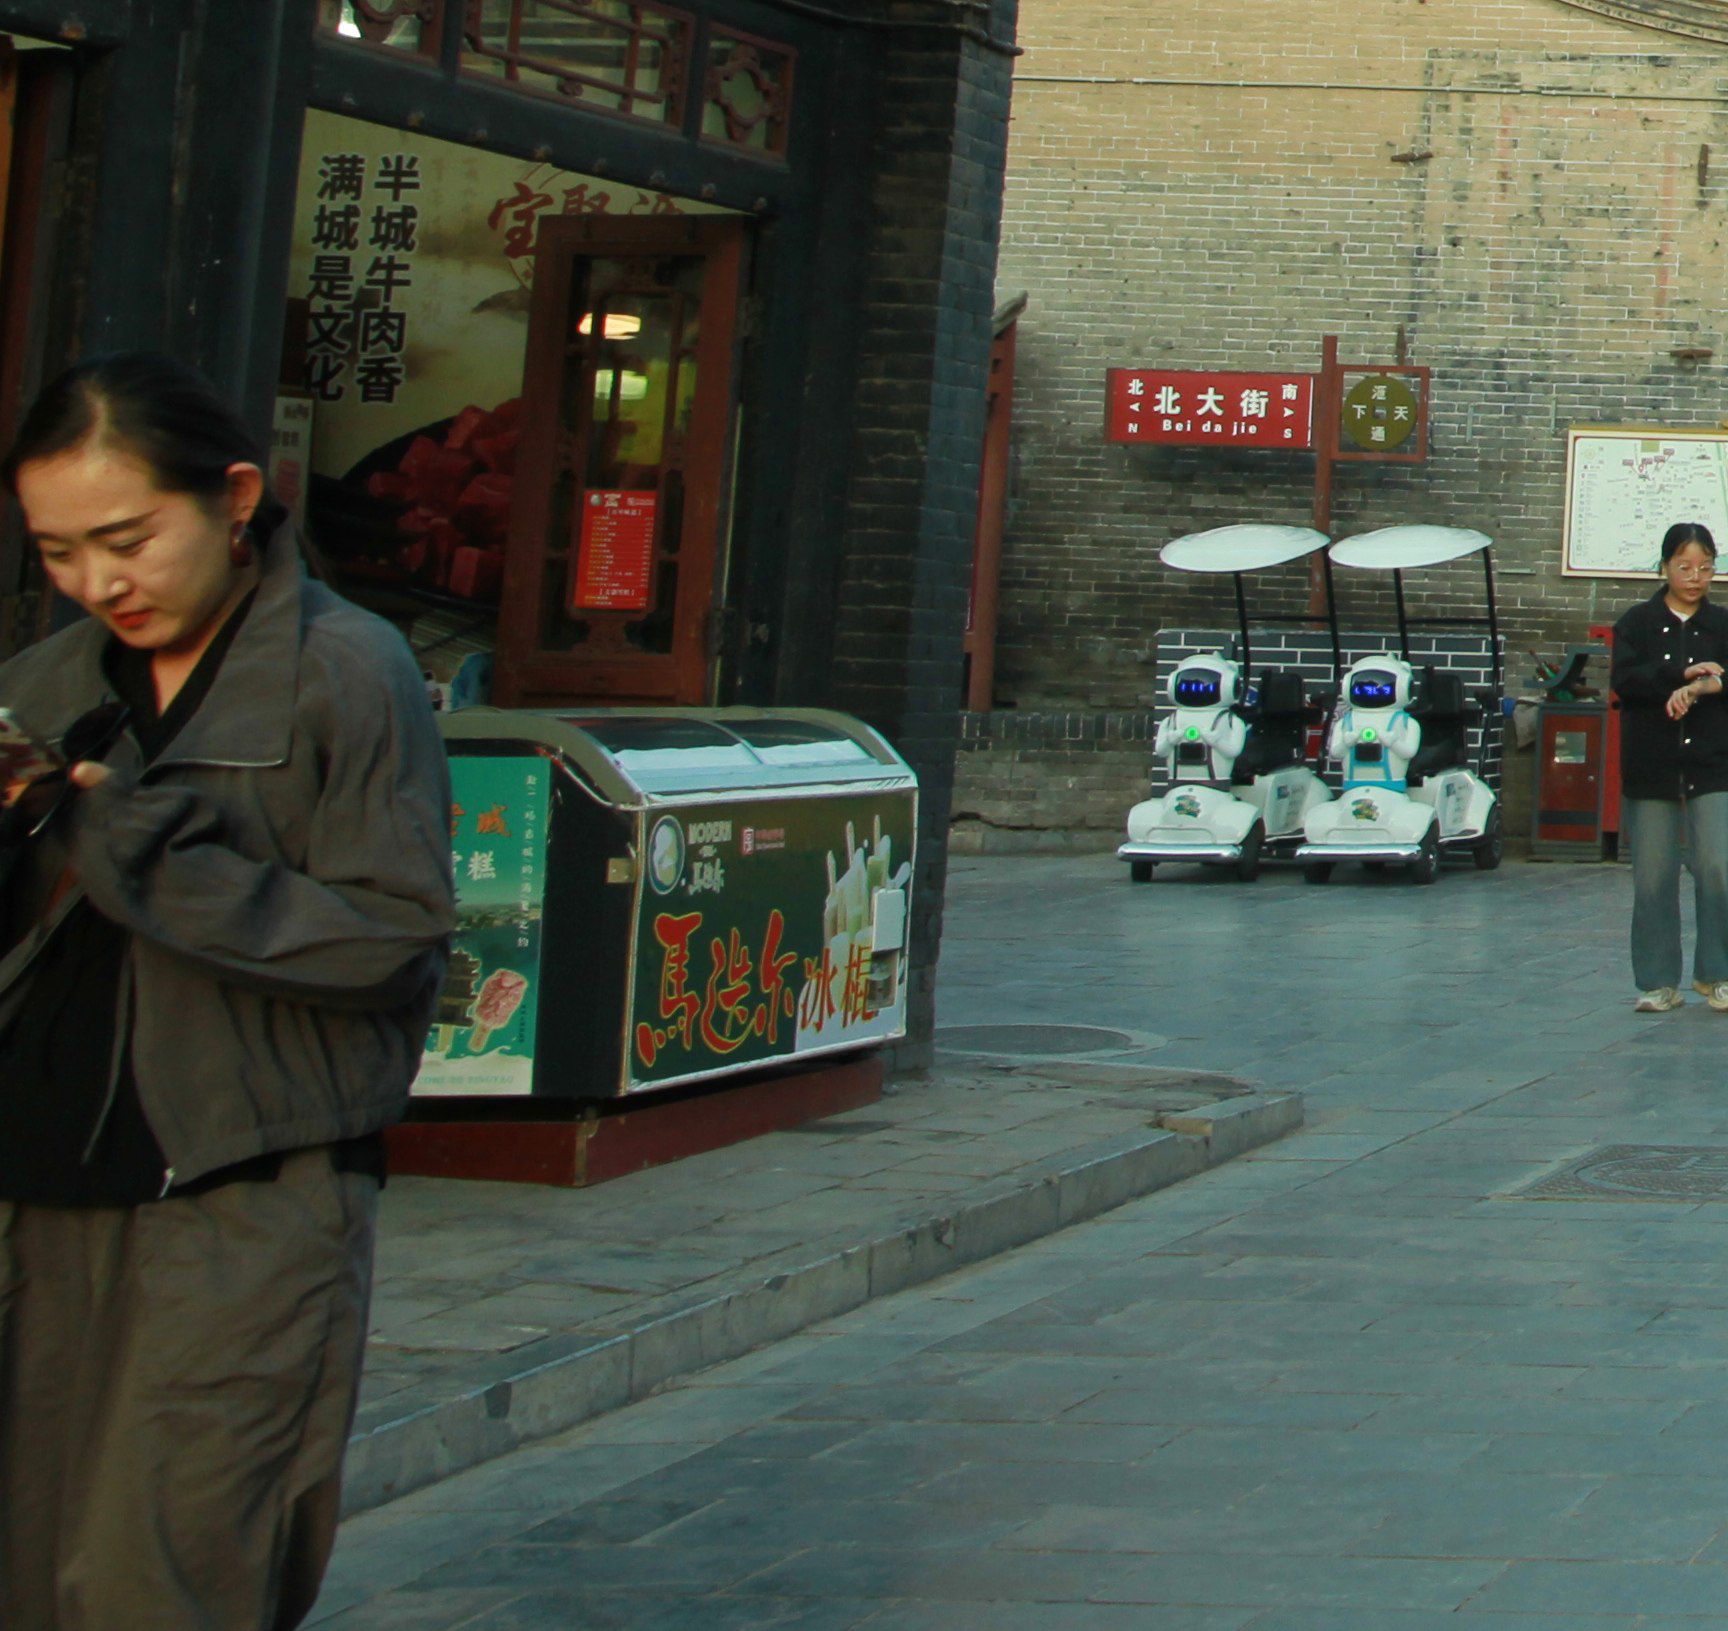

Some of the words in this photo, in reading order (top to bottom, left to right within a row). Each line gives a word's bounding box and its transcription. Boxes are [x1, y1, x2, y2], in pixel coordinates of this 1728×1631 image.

[305, 153, 366, 402] 满城是文化
[355, 154, 420, 404] 半城牛肉香
[1128, 379, 1144, 395] 北
[1282, 383, 1298, 400] 南
[1153, 386, 1269, 418] 北大街
[1128, 423, 1138, 433] N
[1162, 419, 1191, 432] Bei
[1202, 420, 1222, 433] da
[1232, 421, 1257, 435] jie
[1283, 427, 1292, 439] S
